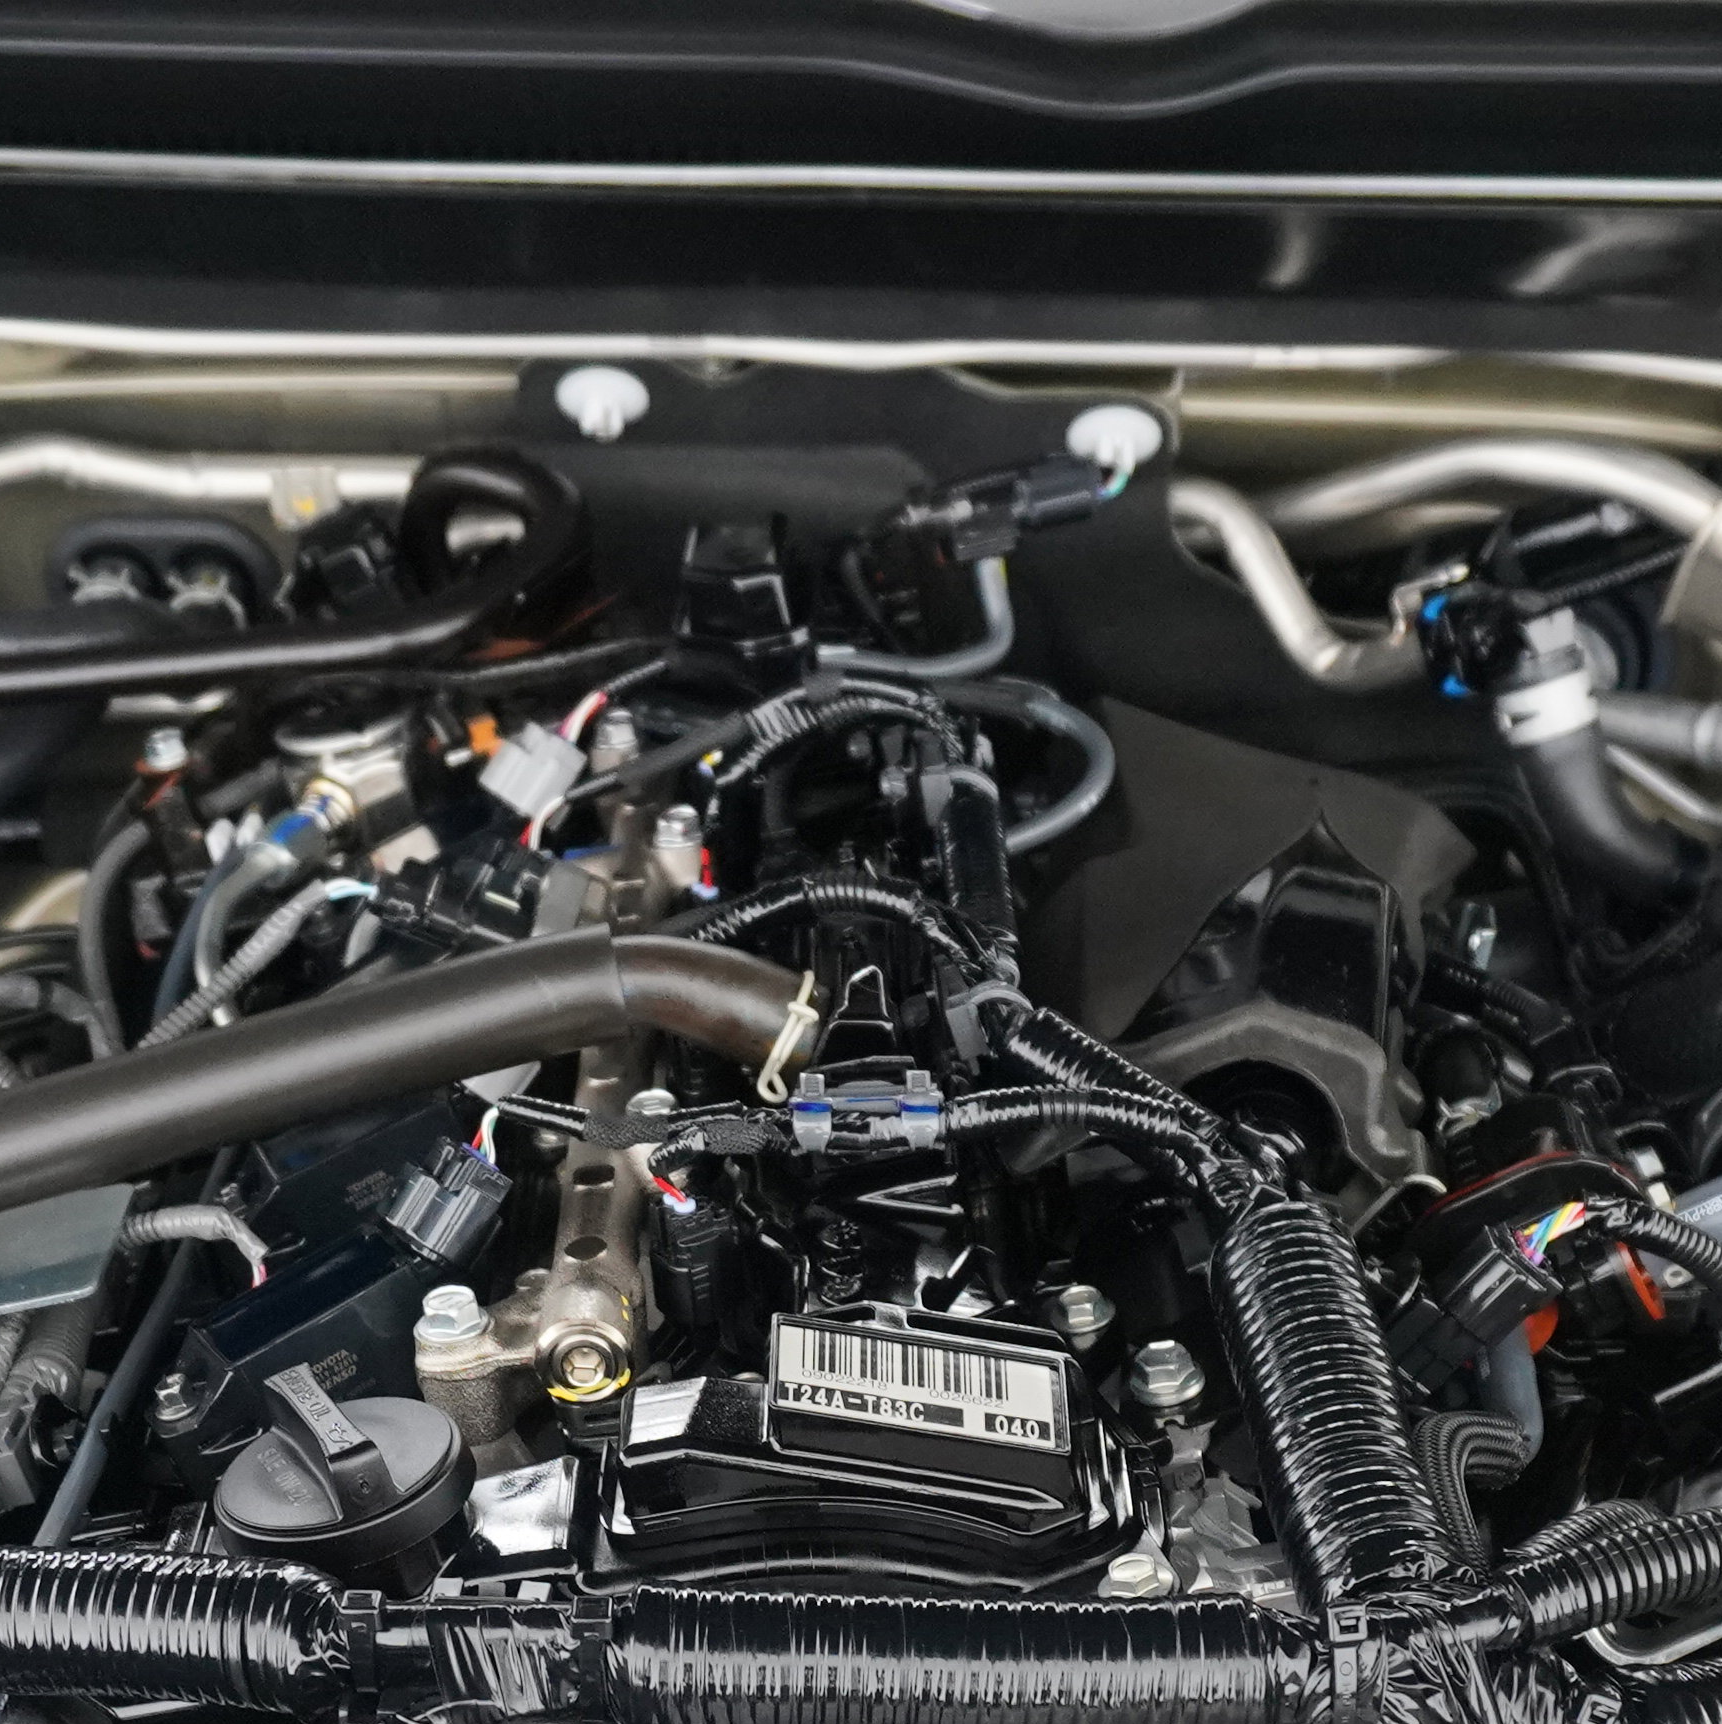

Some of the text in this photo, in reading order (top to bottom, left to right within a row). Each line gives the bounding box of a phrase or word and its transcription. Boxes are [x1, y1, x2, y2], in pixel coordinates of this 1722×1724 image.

[311, 1349, 349, 1374] OYOTA
[307, 1401, 332, 1421] OIL
[785, 1383, 1040, 1440] T24A-T83C 040
